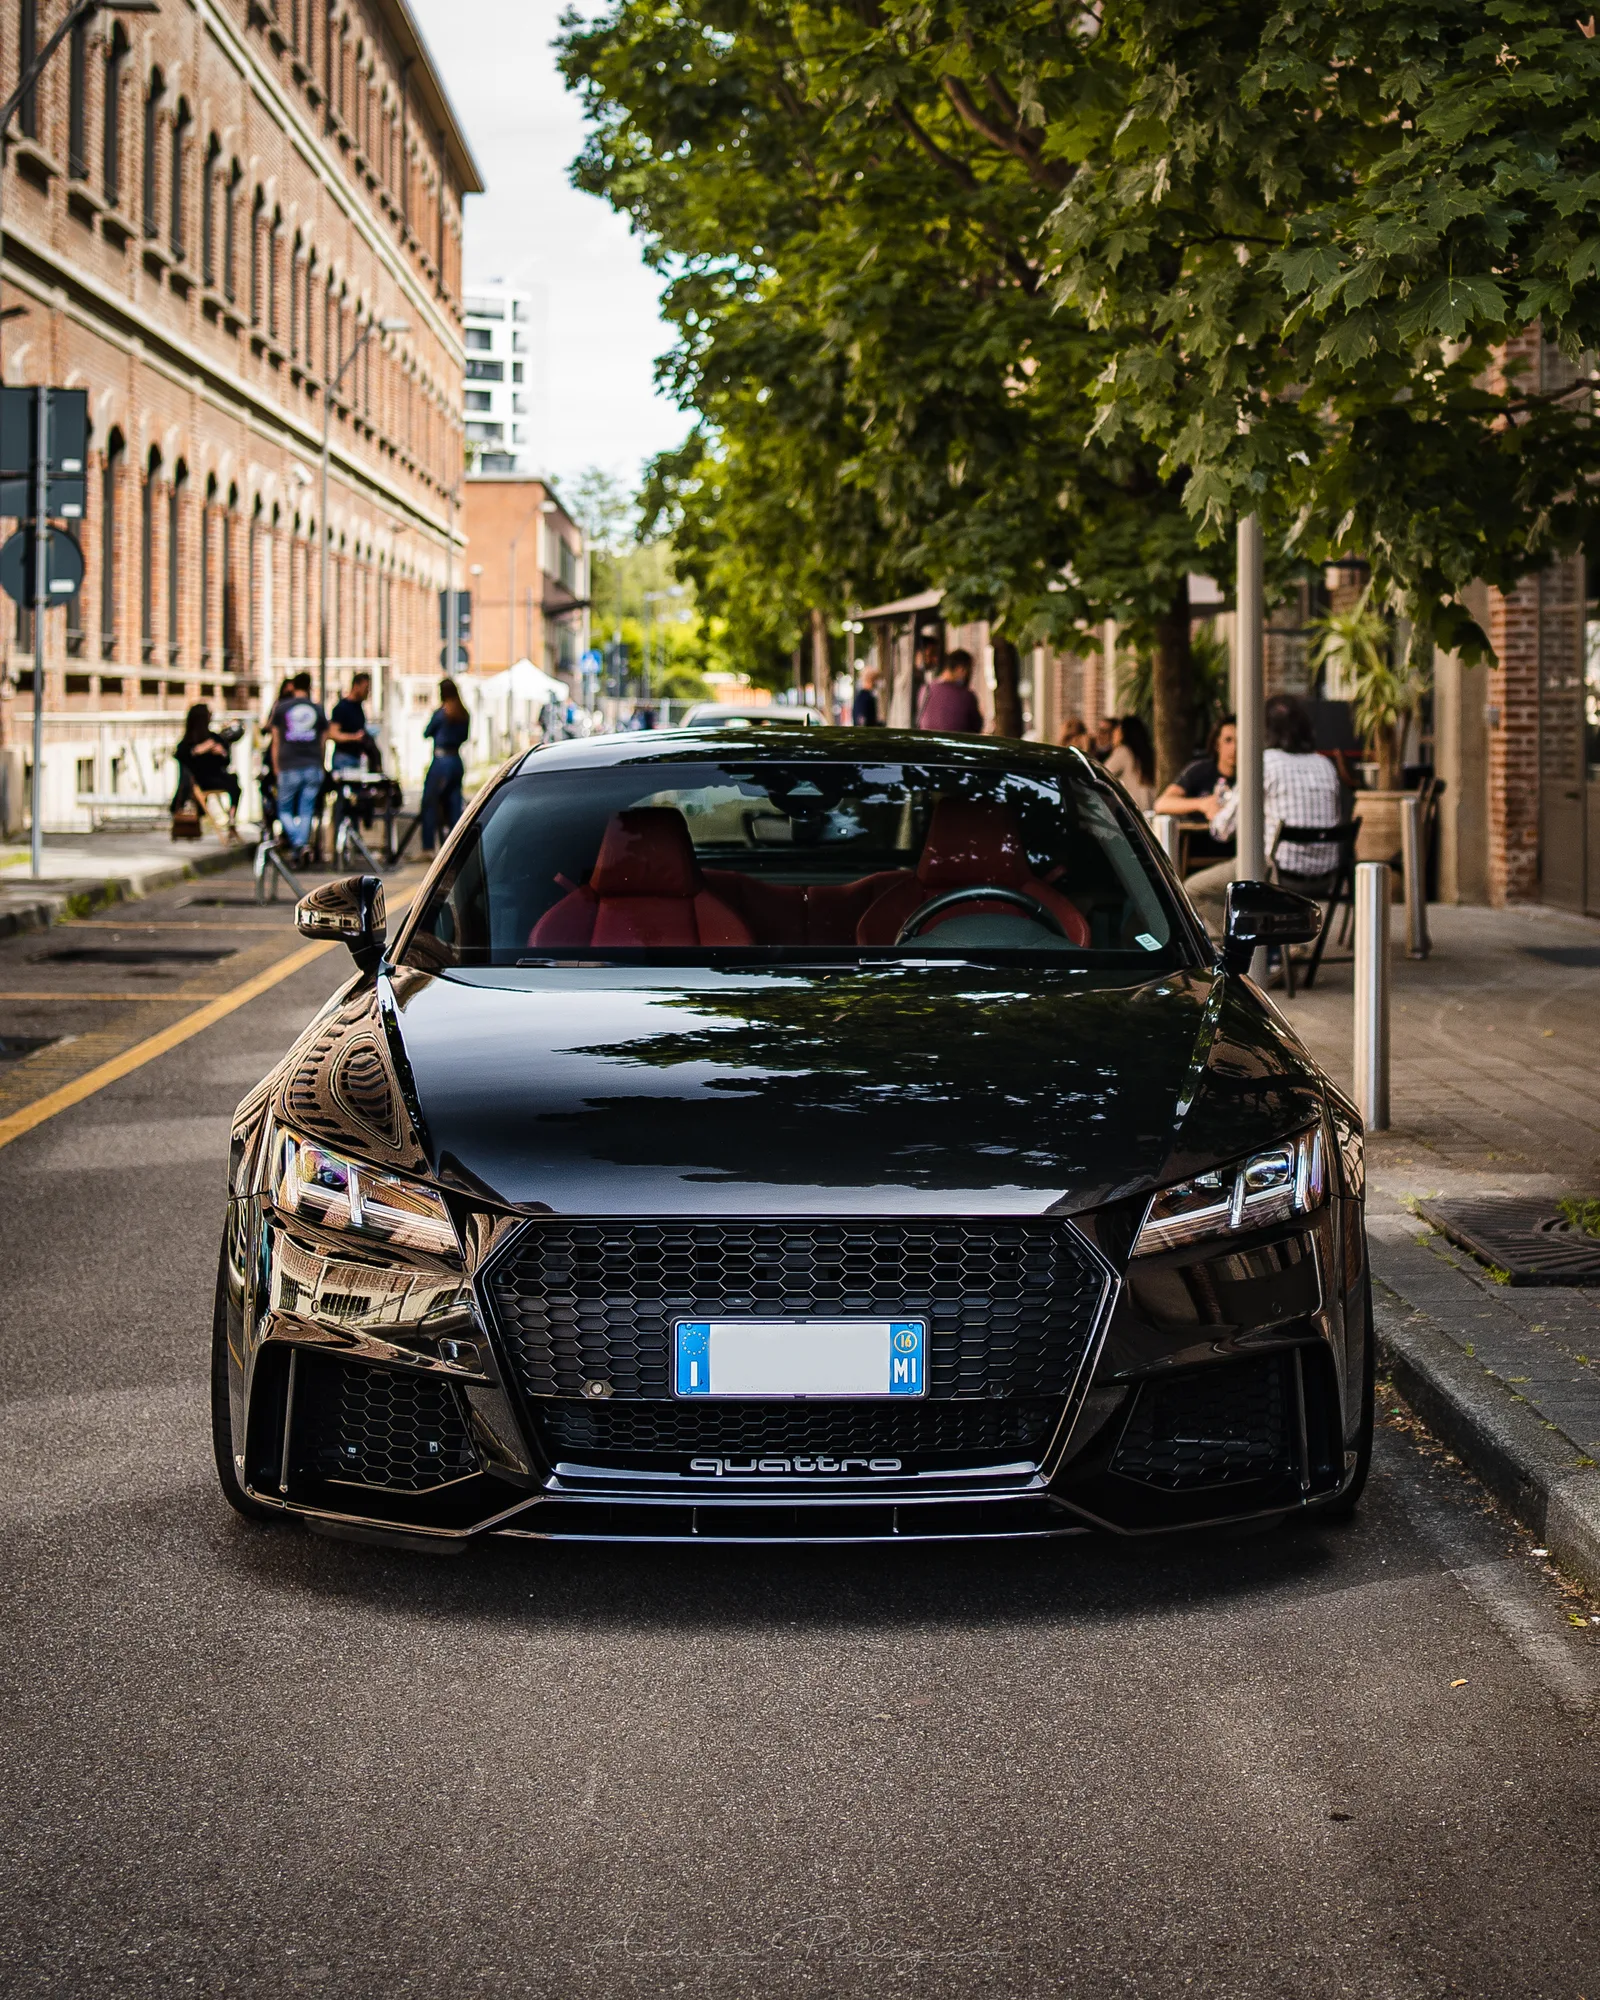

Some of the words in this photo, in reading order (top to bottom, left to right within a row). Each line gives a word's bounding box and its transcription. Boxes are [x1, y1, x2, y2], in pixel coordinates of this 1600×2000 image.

[901, 1334, 912, 1348] 16
[690, 1361, 698, 1387] I
[893, 1357, 917, 1384] MI
[690, 1455, 902, 1476] quattro
